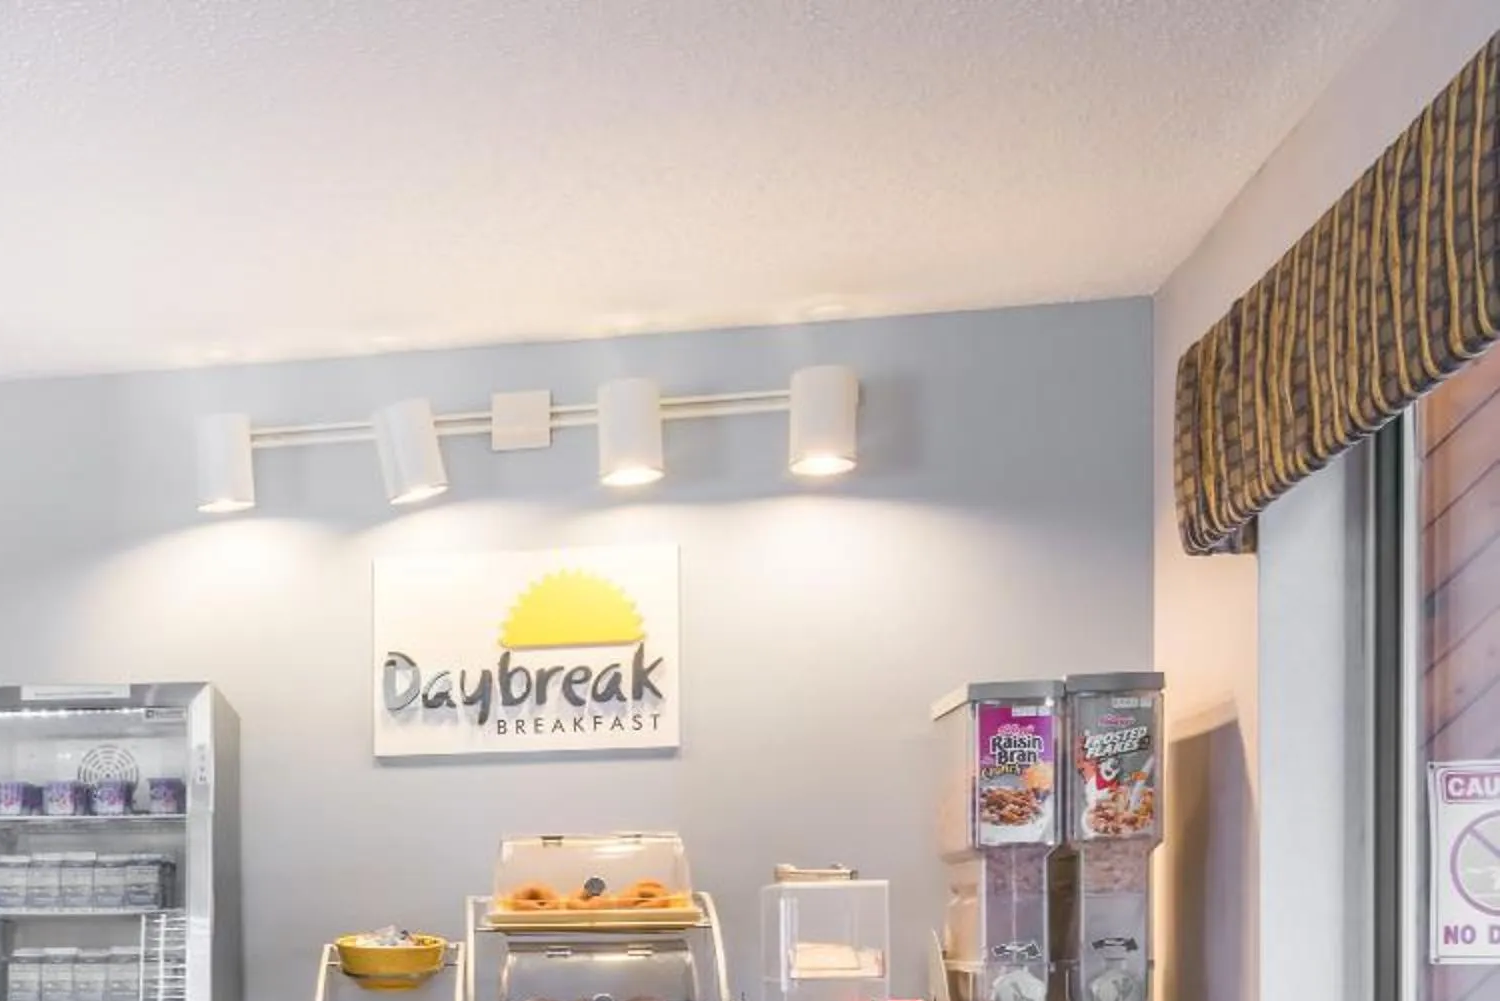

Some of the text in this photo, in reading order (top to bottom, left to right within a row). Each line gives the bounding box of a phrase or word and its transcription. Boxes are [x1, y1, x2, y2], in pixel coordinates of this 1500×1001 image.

[382, 642, 664, 726] Daybreak
[497, 714, 662, 735] BREAKFAST
[991, 735, 1043, 752] Raisin
[1083, 726, 1148, 750] FROSTED
[997, 750, 1037, 765] Bran
[1085, 739, 1140, 759] FLAKES
[1443, 925, 1477, 945] NO
